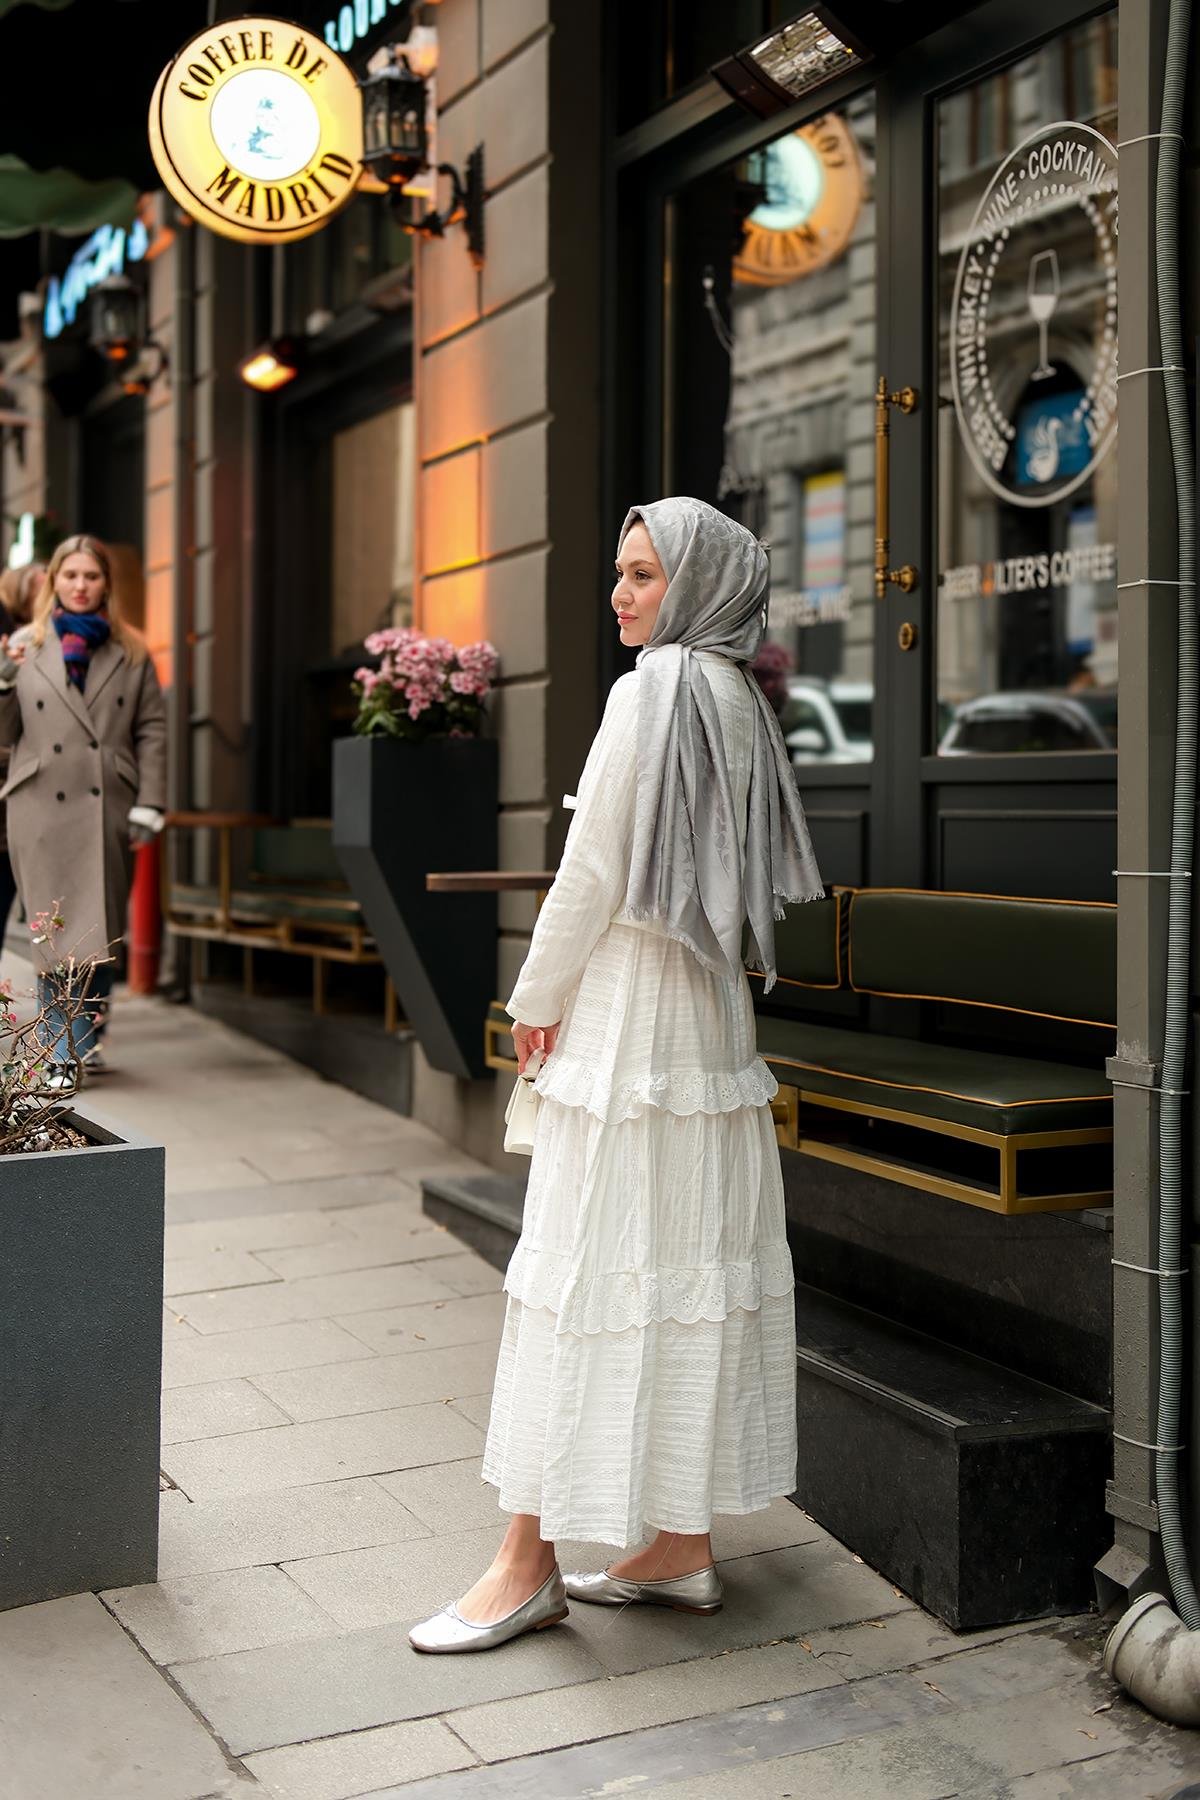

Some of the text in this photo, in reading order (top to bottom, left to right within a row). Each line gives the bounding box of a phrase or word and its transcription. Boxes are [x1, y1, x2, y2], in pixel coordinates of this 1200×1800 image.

[178, 31, 328, 102] COFFEE DE
[957, 255, 984, 396] WHISKEY
[982, 172, 1020, 242] WINE
[1050, 544, 1116, 586] COFFEE
